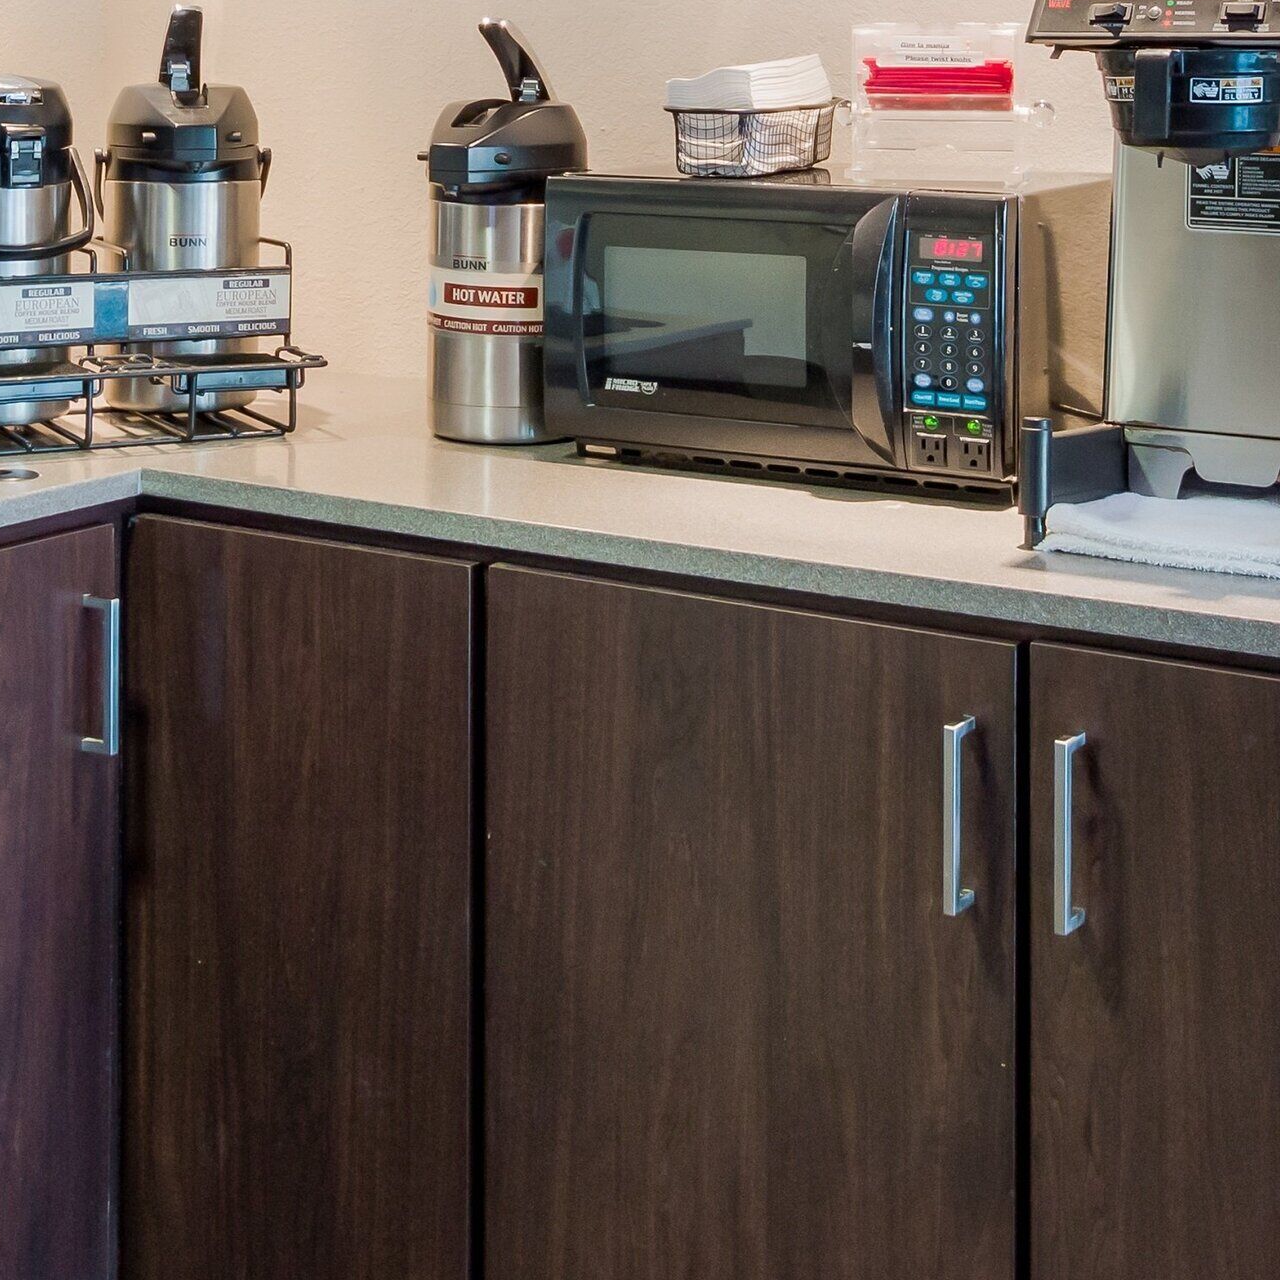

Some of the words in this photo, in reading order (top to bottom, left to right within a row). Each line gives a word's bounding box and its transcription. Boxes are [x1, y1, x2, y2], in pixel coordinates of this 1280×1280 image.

[170, 237, 207, 247] BUNN
[452, 259, 487, 271] BUNN
[229, 279, 263, 288] REGULAR
[28, 288, 64, 297] REGULAR
[216, 288, 277, 301] EUROPEAN
[452, 287, 476, 302] HOT
[477, 290, 525, 305] WATER
[15, 297, 80, 311] EUROPEAN
[143, 326, 167, 336] FRESH
[187, 324, 220, 334] SMOOTH
[238, 322, 277, 331] DELICIOUS
[443, 319, 472, 331] CAUTION
[472, 323, 487, 332] HOT
[492, 324, 527, 333] CAUTION
[528, 324, 543, 333] HOT
[38, 331, 80, 342] DELICIOUS
